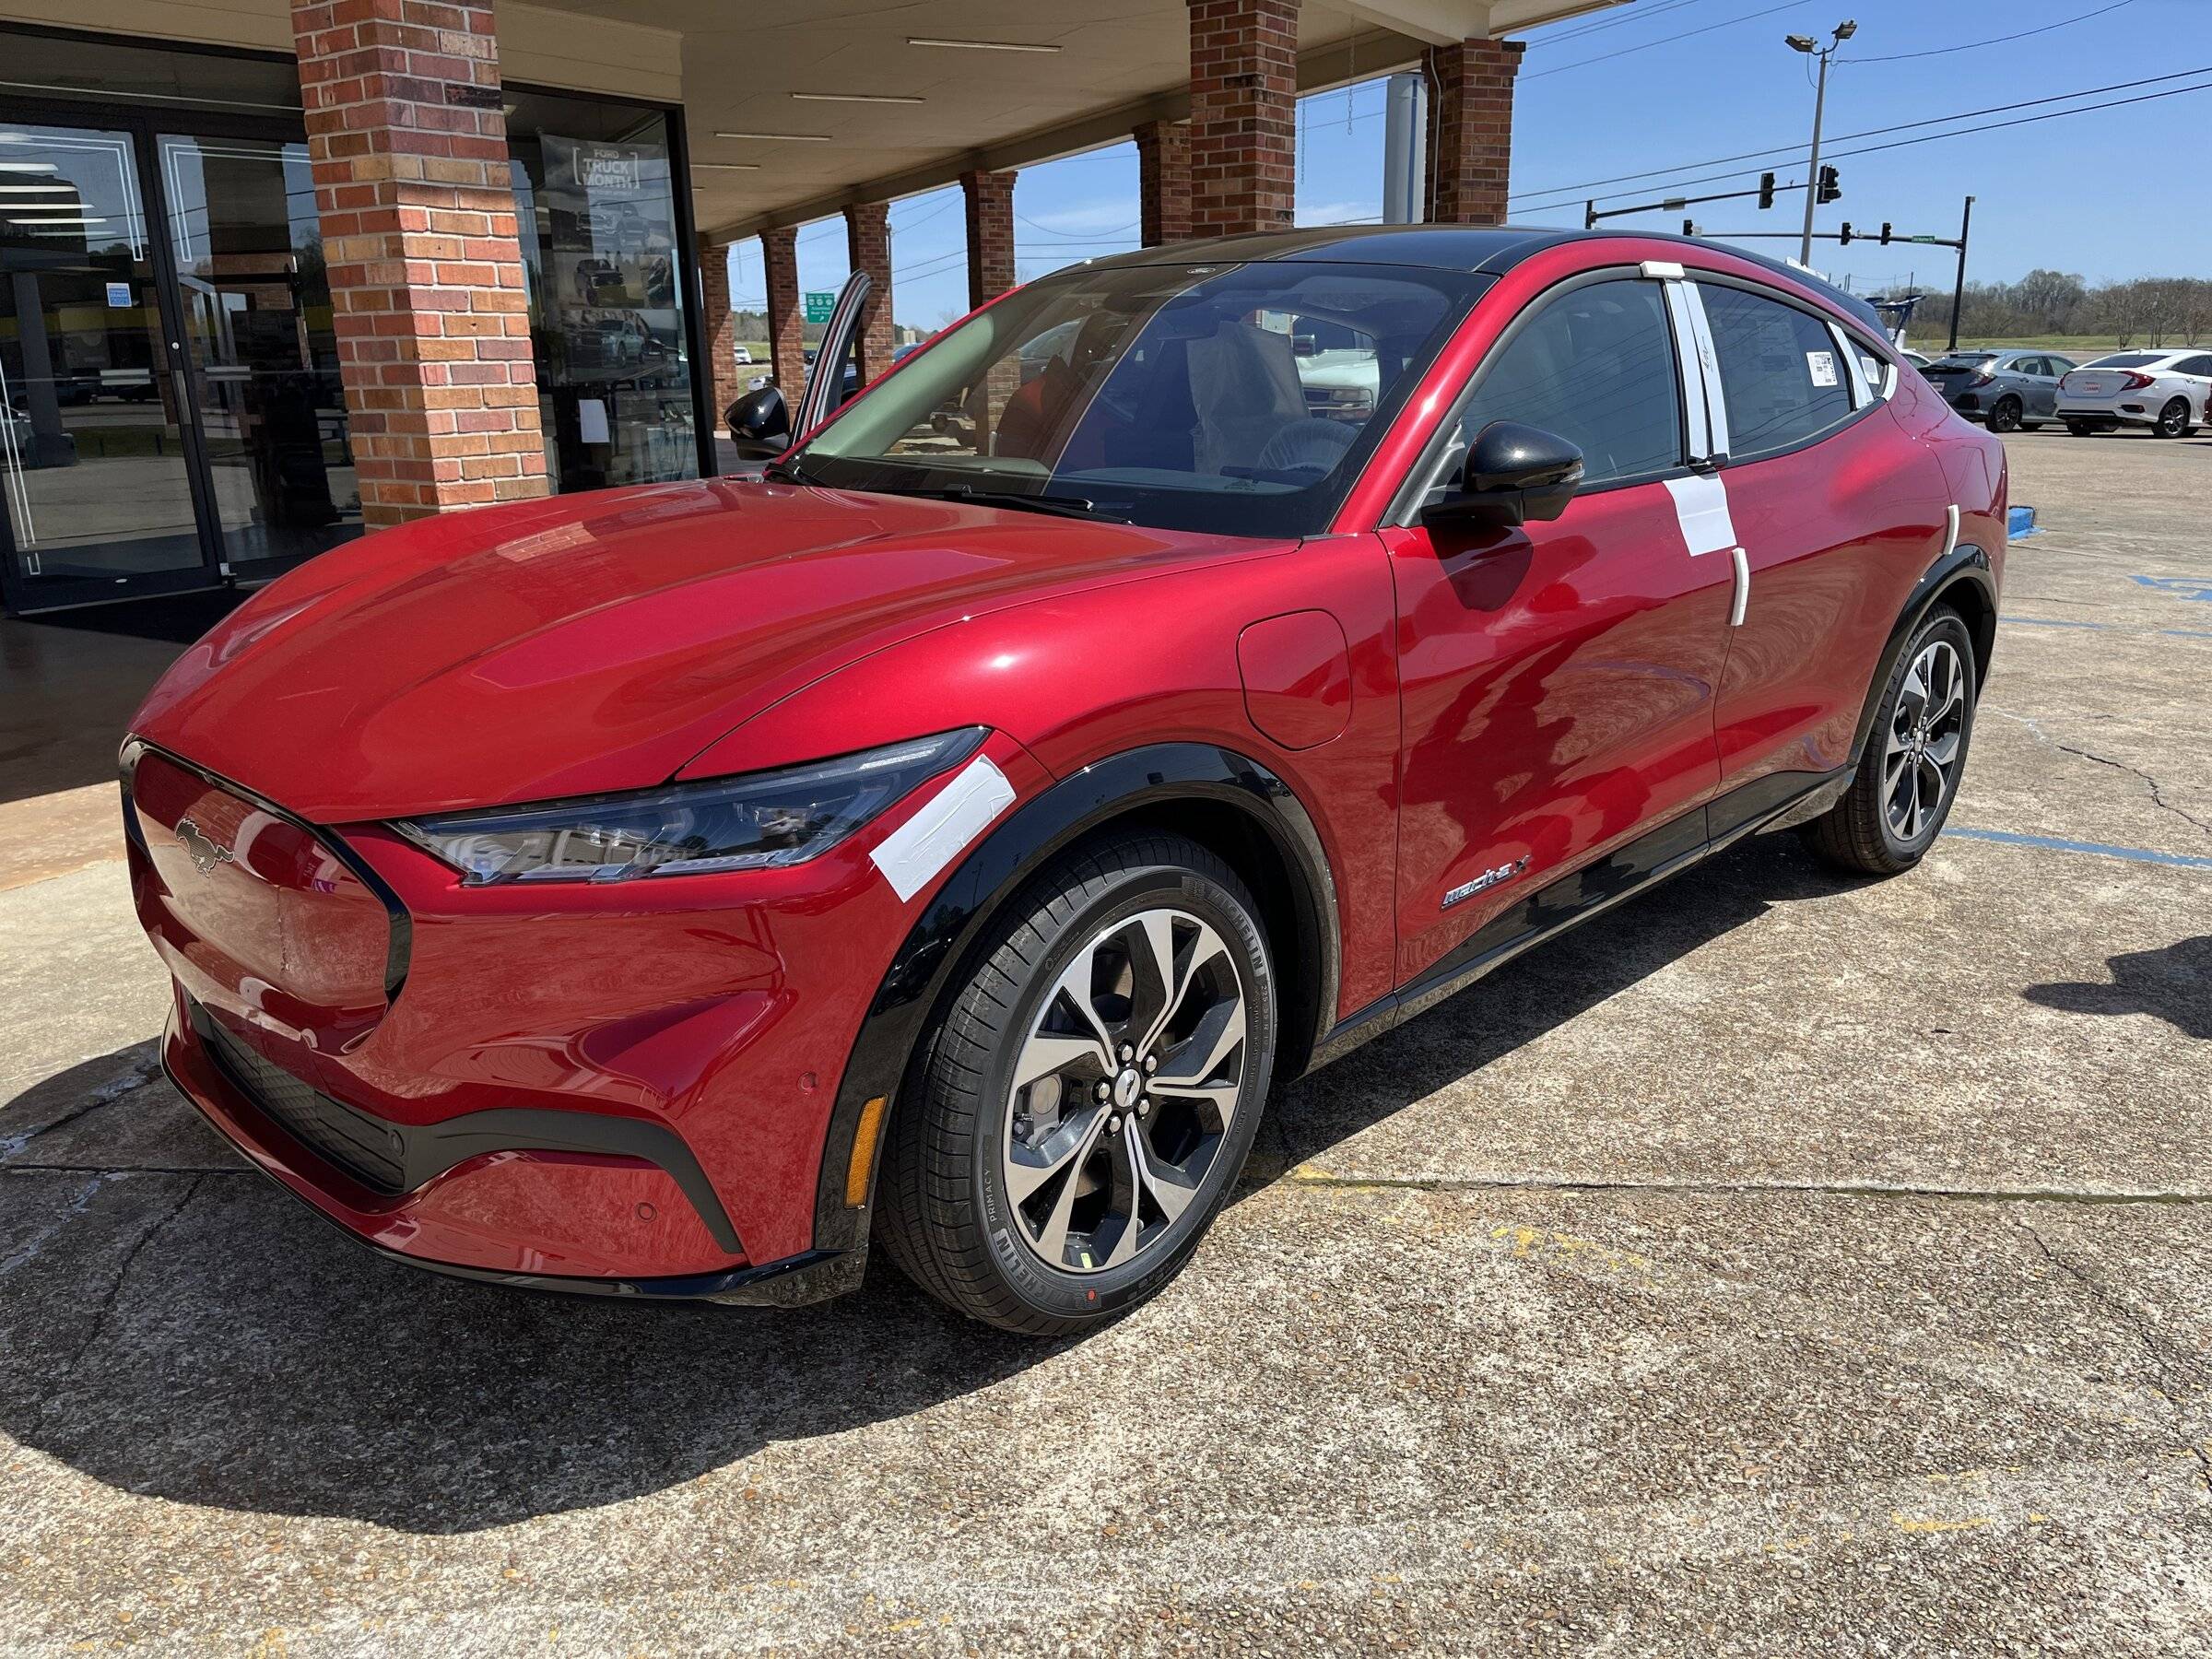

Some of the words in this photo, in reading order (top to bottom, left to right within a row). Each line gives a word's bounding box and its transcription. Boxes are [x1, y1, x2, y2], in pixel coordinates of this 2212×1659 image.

[594, 148, 620, 159] FORD
[582, 158, 629, 175] TRUCK
[582, 172, 633, 190] MONTH
[982, 1168, 998, 1222] PRIMACY
